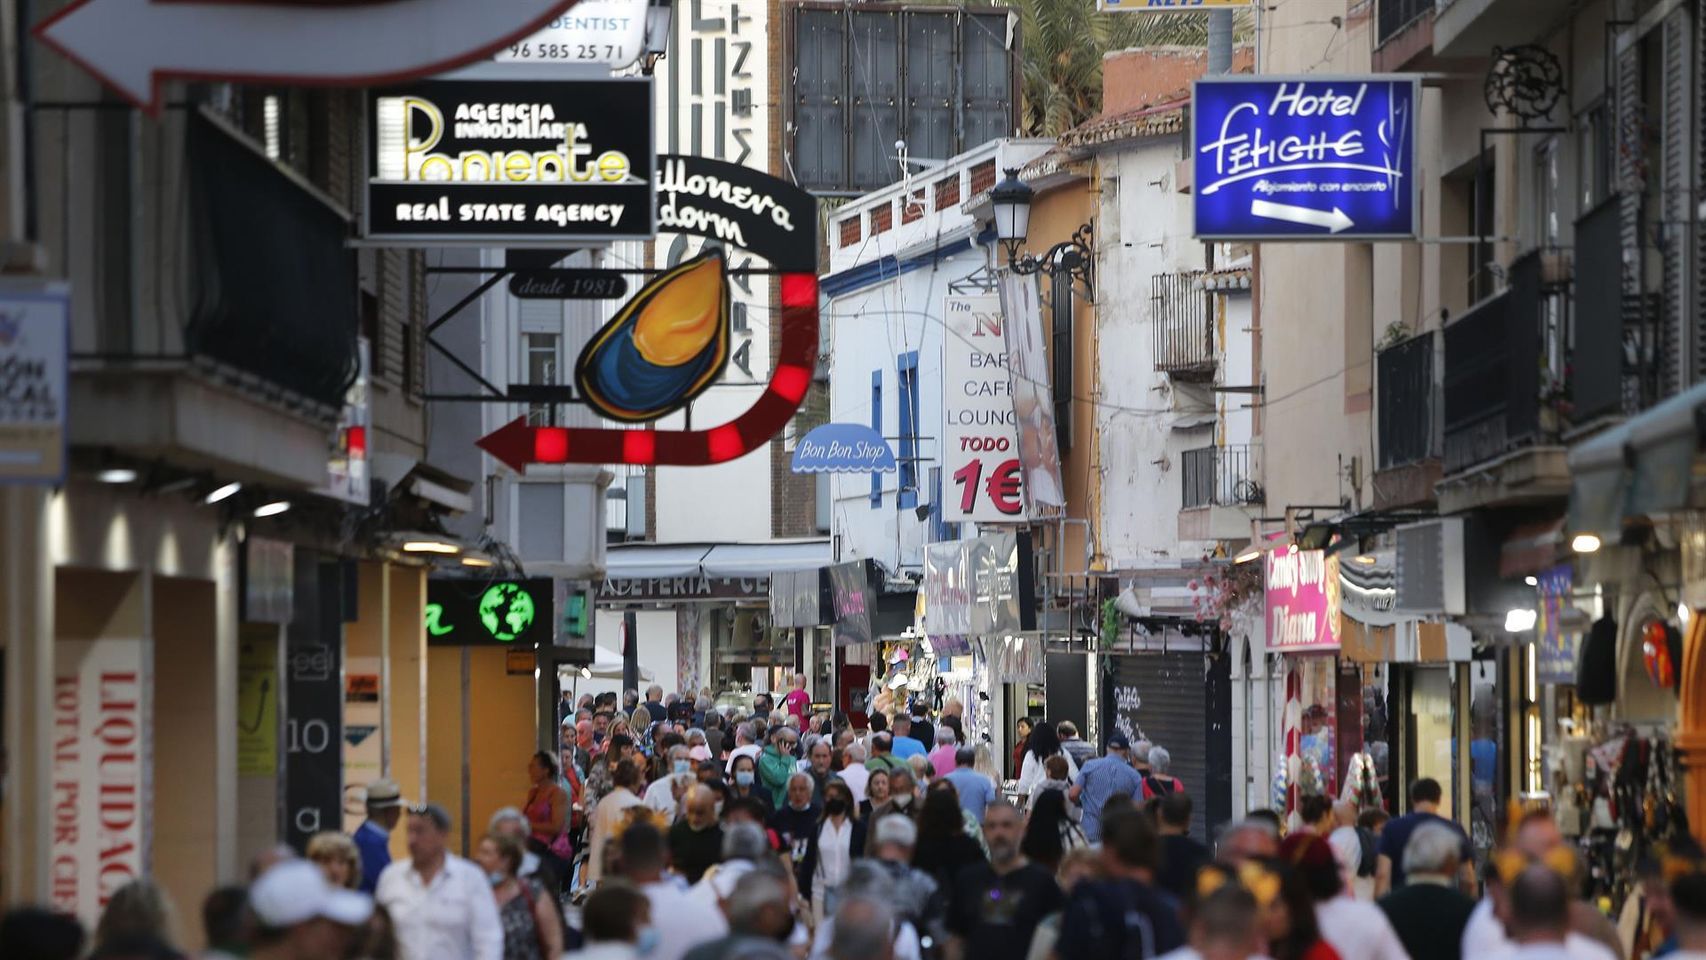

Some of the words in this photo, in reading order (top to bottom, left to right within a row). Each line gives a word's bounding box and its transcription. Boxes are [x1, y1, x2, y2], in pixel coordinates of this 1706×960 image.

[511, 43, 530, 58] 96
[538, 44, 569, 59] 585
[577, 45, 597, 60] 25
[605, 45, 623, 60] 71
[454, 103, 556, 123] AGENCIA
[1268, 83, 1367, 117] Hotel
[404, 96, 631, 182] Poniente
[1252, 179, 1318, 195] Alojamiento
[1319, 182, 1340, 192] con
[1342, 180, 1387, 192] encanto
[396, 196, 450, 221] REAL
[458, 204, 526, 221] STATE
[534, 204, 625, 227] AGENCY
[657, 191, 748, 248] dorm
[518, 277, 565, 295] desde
[571, 278, 616, 295] 1981
[949, 301, 971, 312] The
[800, 440, 825, 459] Bon
[827, 440, 852, 459] Bon
[853, 441, 885, 465] Shop
[960, 436, 1009, 452] TODO
[953, 458, 1023, 515] 1€
[595, 575, 711, 597] AFETERIA
[1271, 605, 1316, 645] Diana
[55, 674, 81, 771] TOTAL
[54, 781, 80, 845] POR
